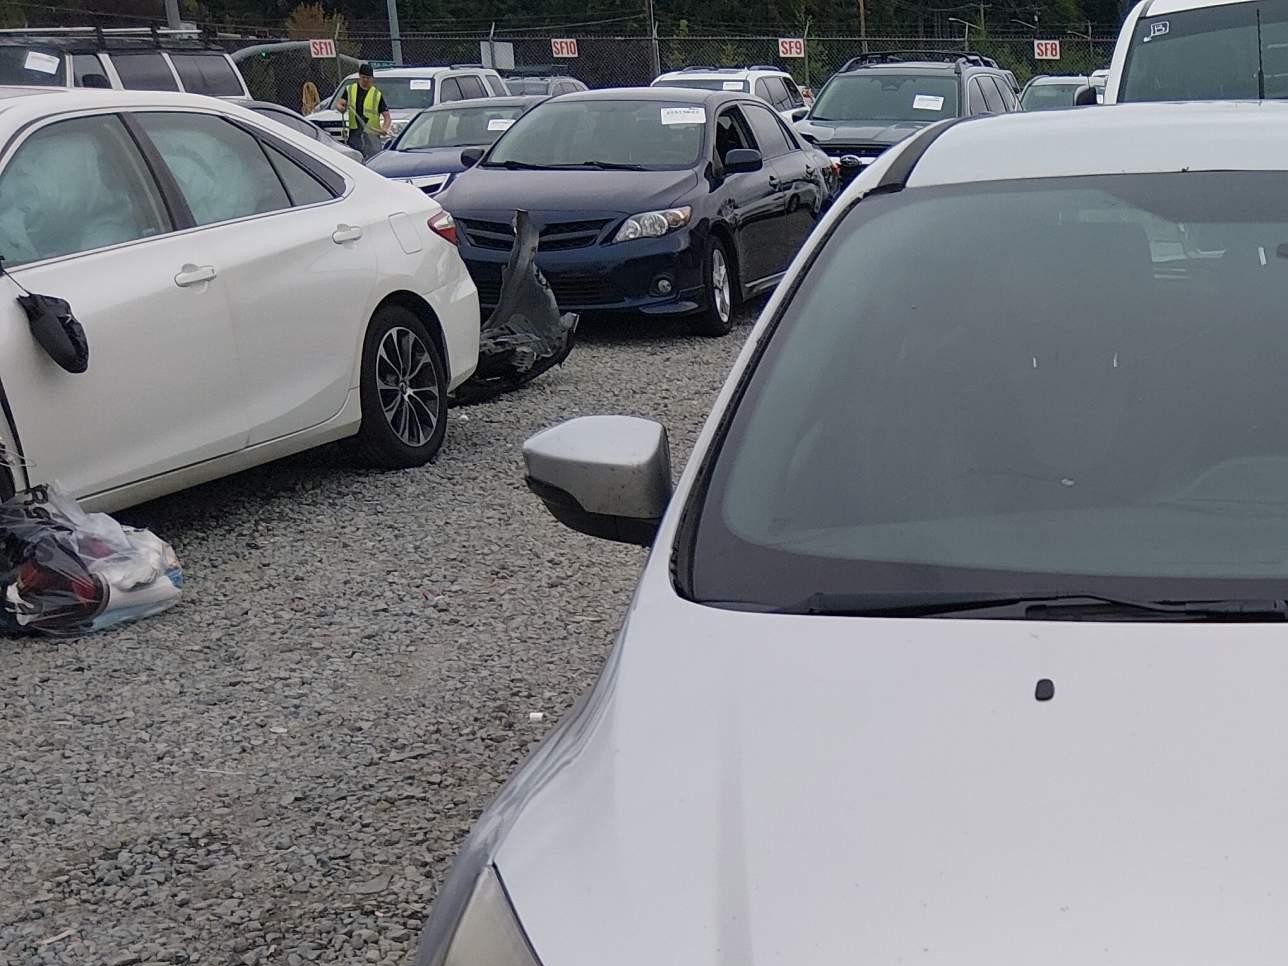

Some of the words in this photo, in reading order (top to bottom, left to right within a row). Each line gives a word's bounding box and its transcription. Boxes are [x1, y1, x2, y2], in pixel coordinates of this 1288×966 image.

[312, 41, 333, 56] SF11
[552, 40, 577, 56] SF10
[780, 40, 802, 56] SF9
[1036, 42, 1058, 57] SF8
